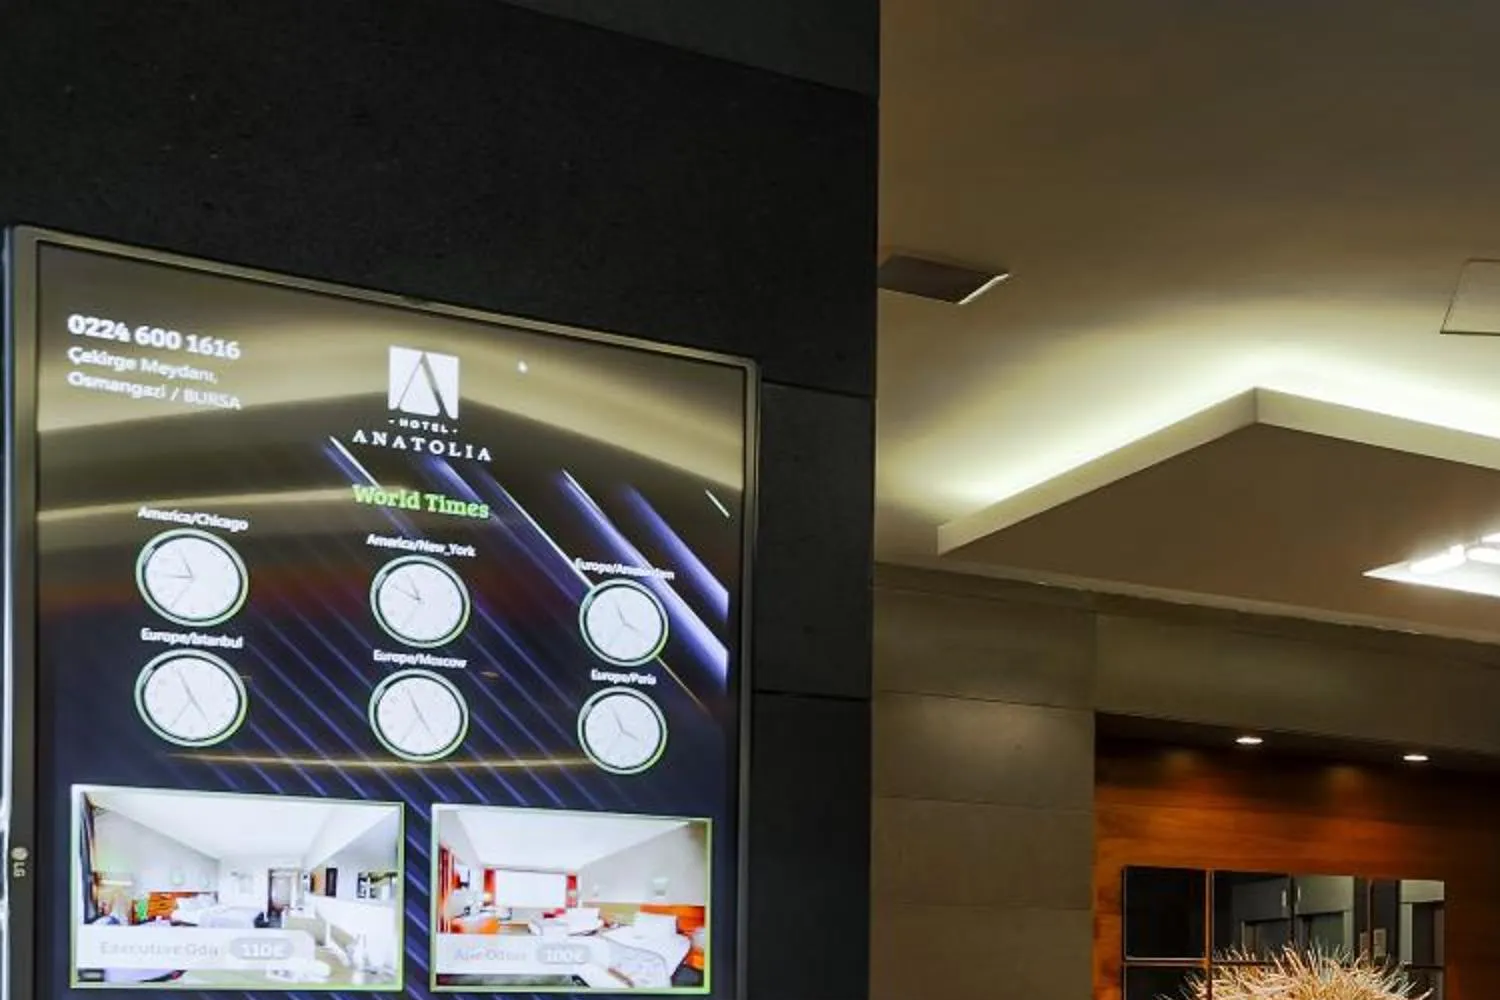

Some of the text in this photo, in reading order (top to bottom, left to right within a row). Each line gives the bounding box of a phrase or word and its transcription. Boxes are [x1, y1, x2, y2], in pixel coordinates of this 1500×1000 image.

[67, 314, 241, 360] 0224 600 1616
[67, 346, 137, 372] Çekirge
[67, 371, 166, 399] Osmangazi
[183, 388, 242, 410] BURSA
[399, 418, 449, 434] HOTEL
[352, 429, 492, 462] ANATOLIA
[351, 484, 491, 518] World Times
[137, 505, 249, 532] America/Chicago
